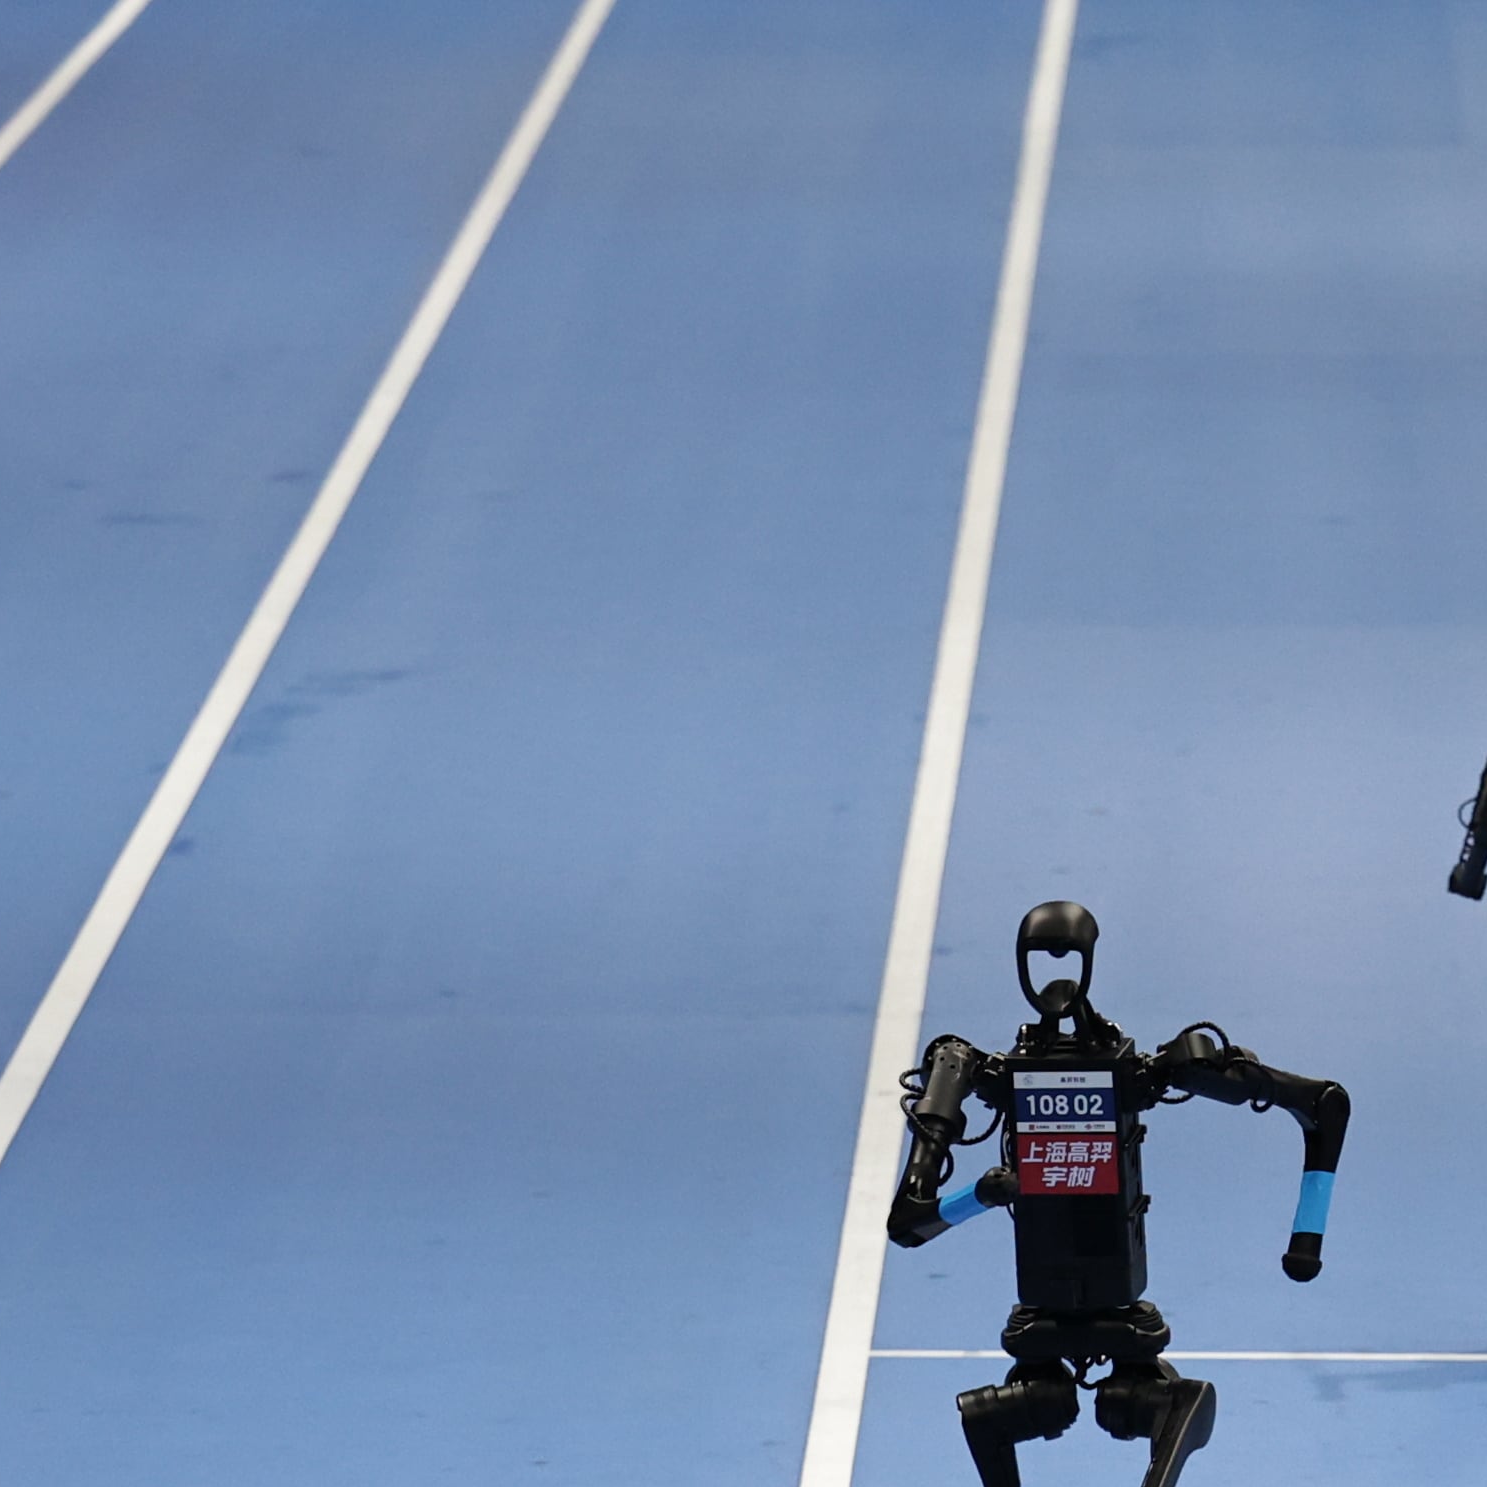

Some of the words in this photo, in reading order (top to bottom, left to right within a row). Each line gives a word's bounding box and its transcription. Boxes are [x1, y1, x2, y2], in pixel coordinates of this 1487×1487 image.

[1021, 1141, 1113, 1163] 上海高羿
[1041, 1165, 1096, 1188] 宇树
